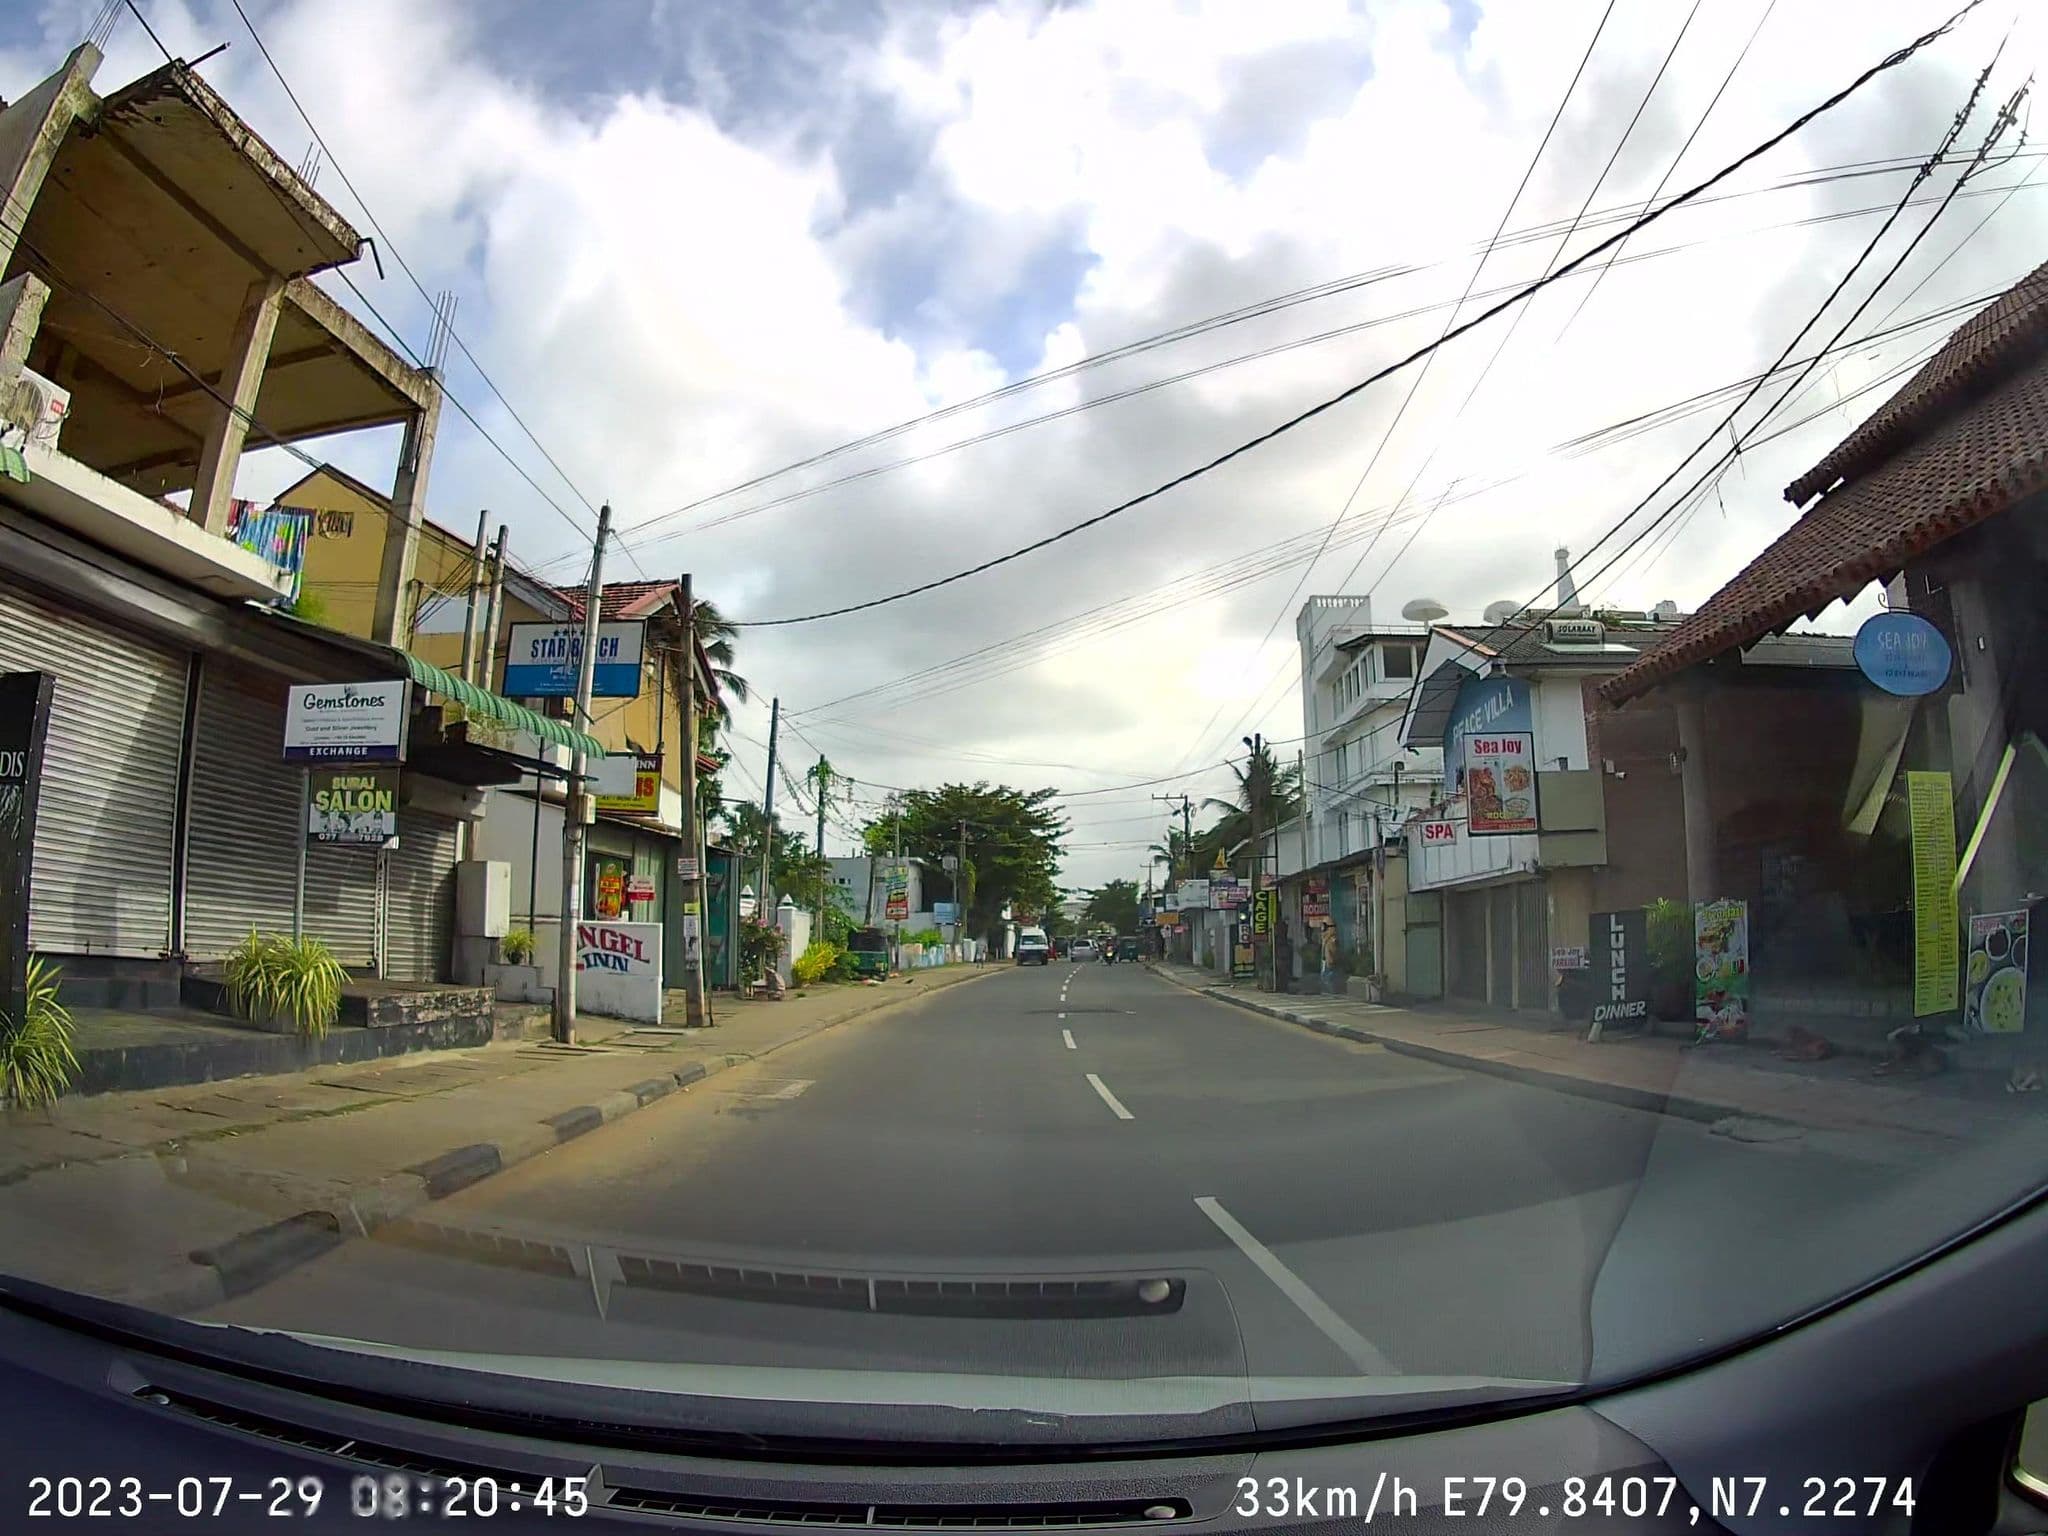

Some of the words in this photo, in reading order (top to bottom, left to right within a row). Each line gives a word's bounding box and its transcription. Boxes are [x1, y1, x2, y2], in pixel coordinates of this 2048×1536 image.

[531, 638, 566, 658] STAR
[570, 637, 619, 659] BCH
[303, 693, 386, 710] Gemstones
[1484, 685, 1514, 723] VILLA
[309, 747, 369, 756] EXCHANGE
[1474, 738, 1498, 754] Sea
[1502, 738, 1522, 754] Joy
[315, 790, 392, 812] SALON
[1424, 823, 1454, 839] SPA
[1254, 891, 1268, 934] CAGE
[577, 924, 651, 964] NGEL
[582, 952, 629, 973] INN
[1610, 914, 1626, 1001] LUNCH
[1594, 1000, 1646, 1022] DINNER
